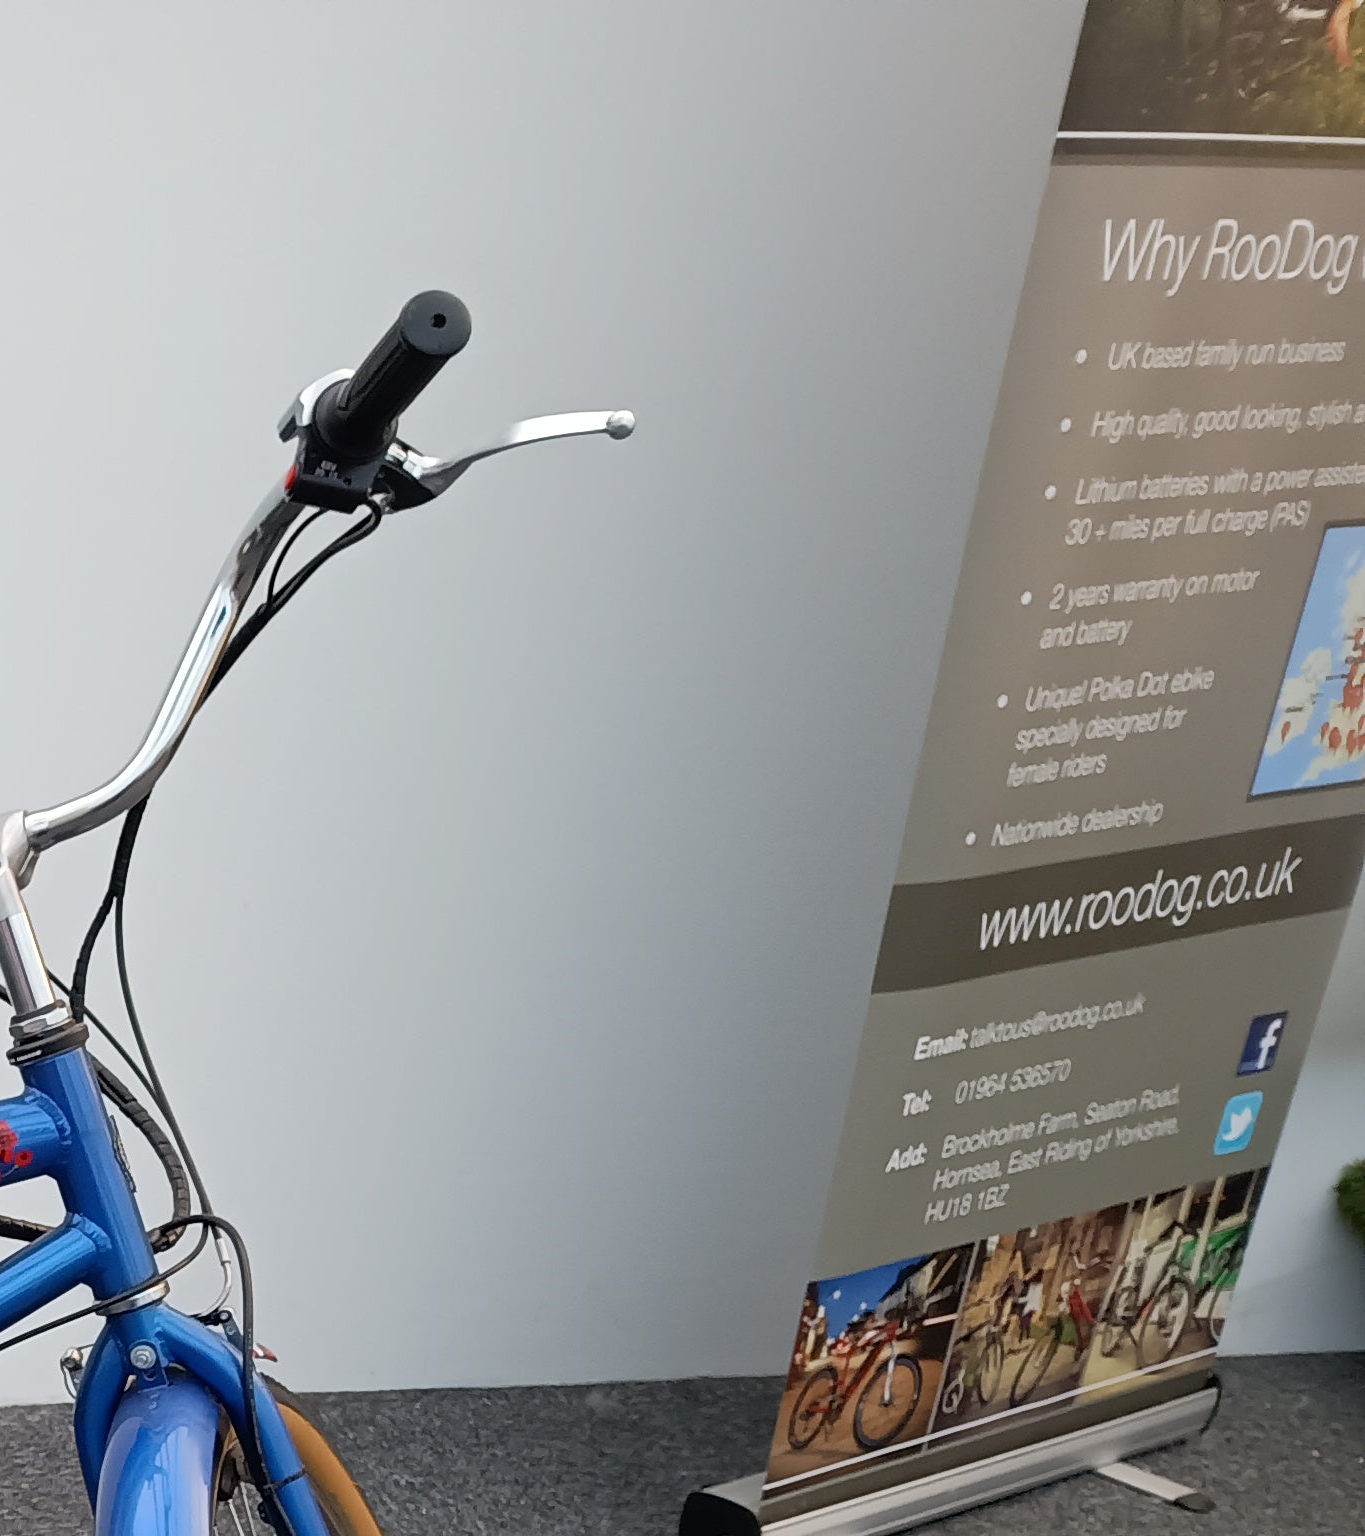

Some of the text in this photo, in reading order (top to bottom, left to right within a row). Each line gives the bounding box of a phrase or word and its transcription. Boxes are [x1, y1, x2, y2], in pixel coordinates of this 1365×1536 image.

[1102, 219, 1200, 297] Why
[1202, 219, 1358, 295] RooDog
[1108, 338, 1346, 371] UK based family run business
[1091, 410, 1135, 443] High
[1191, 404, 1242, 439] good
[1306, 399, 1353, 431] stylish
[1075, 475, 1137, 505] Lithium
[1138, 470, 1208, 500] batteries
[1213, 467, 1249, 494] with
[1250, 471, 1263, 493] a
[1263, 467, 1314, 497] power
[1065, 500, 1311, 545] 30 + miles per full charge (PAS)
[1049, 567, 1260, 614] 2 years warranty on motor
[1039, 618, 1133, 649] and battery
[1089, 675, 1134, 702] Polka
[1137, 671, 1169, 698] Dot
[1170, 666, 1214, 694] ebike
[1015, 704, 1188, 754] specially designed for
[1007, 753, 1108, 787] female riders
[991, 799, 1164, 846] Nationwide dealership
[980, 847, 1303, 950] www.roodog.co.uk
[913, 1028, 968, 1060] Email:
[902, 1089, 932, 1117] Tel:
[955, 1072, 1008, 1104] 01964
[885, 1142, 927, 1173] Add:
[941, 1120, 1036, 1159] Brookholme
[1084, 1097, 1137, 1125] Seaton
[1007, 1148, 1043, 1174] East
[1044, 1138, 1093, 1165] Riding
[1094, 1128, 1114, 1153] of
[924, 1184, 1010, 1225] HU18 1BZ
